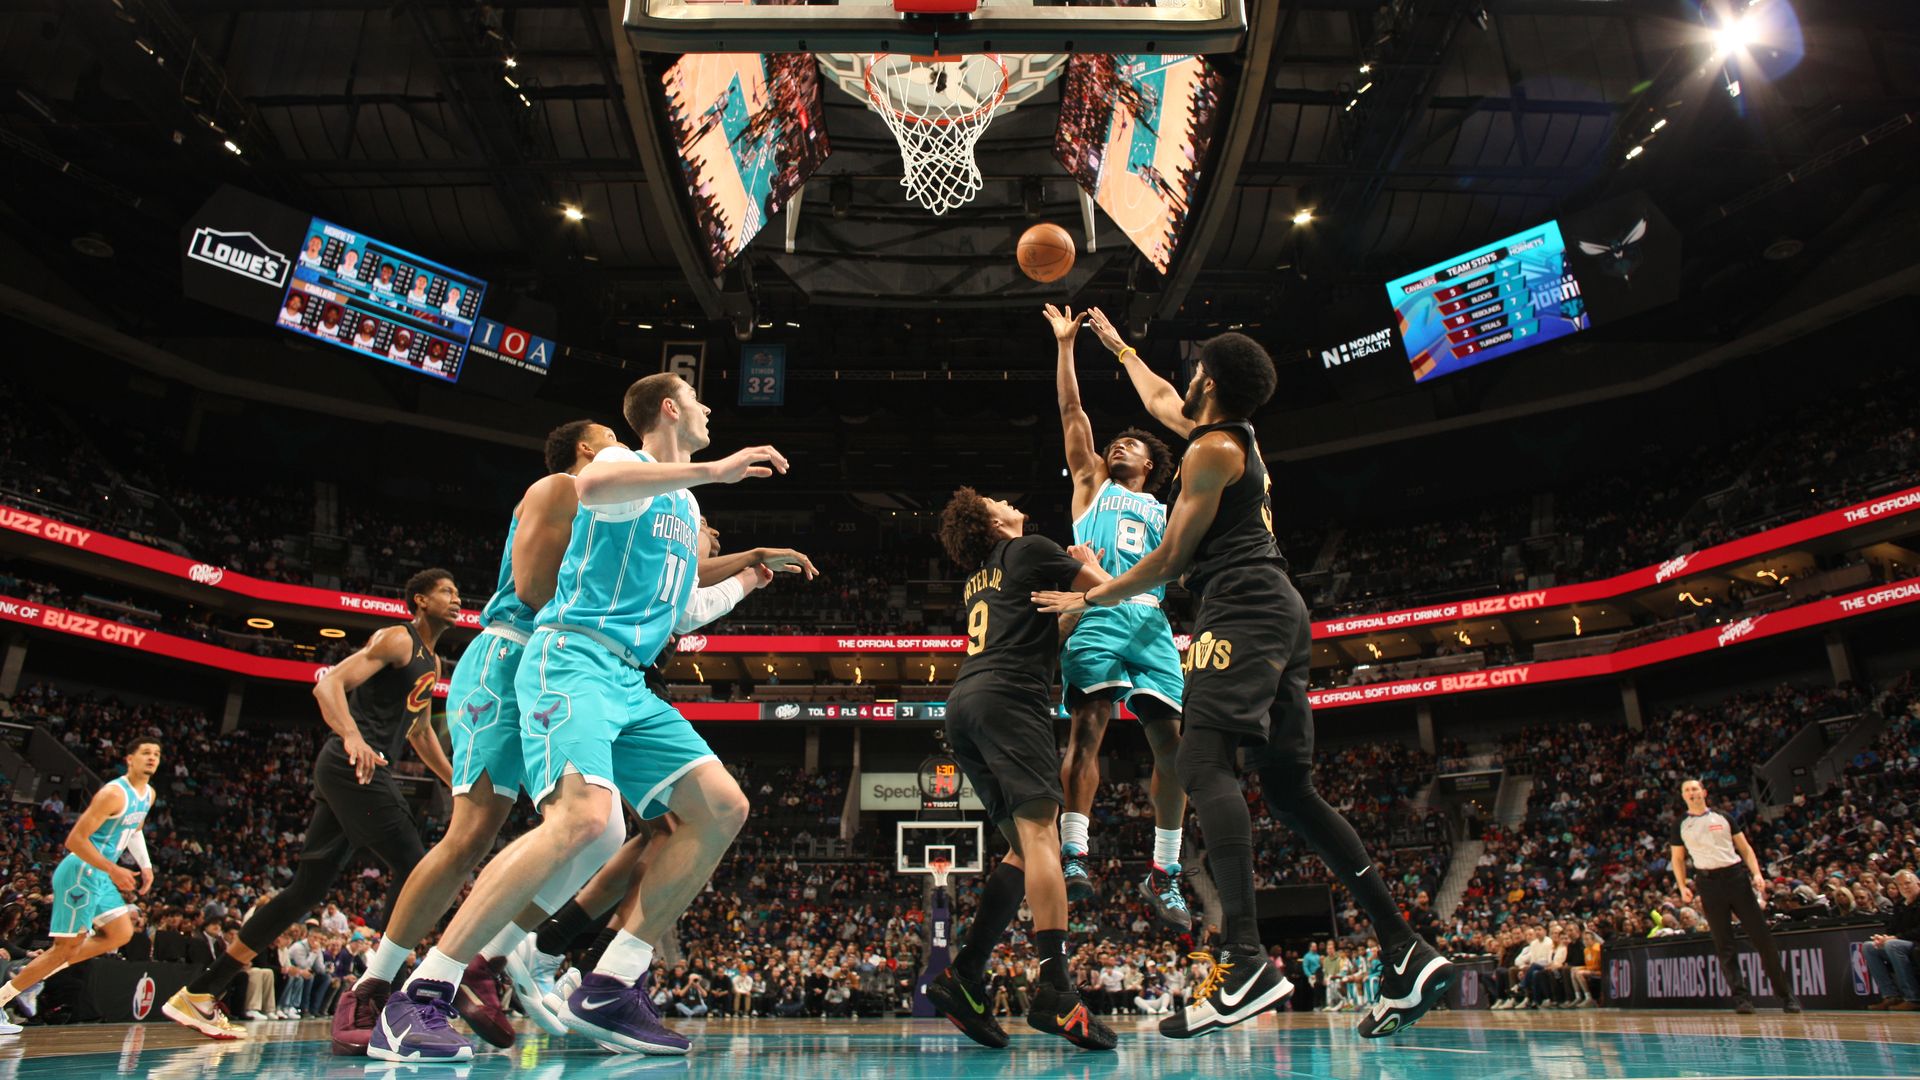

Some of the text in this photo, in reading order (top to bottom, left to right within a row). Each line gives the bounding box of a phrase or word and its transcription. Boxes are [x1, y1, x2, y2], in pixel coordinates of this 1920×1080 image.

[201, 235, 279, 280] LOWE'S
[1446, 262, 1471, 277] TEAM
[1471, 252, 1498, 269] STATS
[1471, 291, 1493, 304] BLOCKS
[1471, 304, 1501, 319] REBOUNDS
[1348, 327, 1391, 350] NOVANT
[1479, 332, 1512, 347] TURNOVERS
[1480, 320, 1501, 332] STEALS
[469, 345, 498, 359] INSURANCE
[499, 355, 517, 366] OFFICE
[525, 363, 547, 376] AMERICA
[1352, 338, 1391, 359] HEALTH
[748, 377, 775, 394] 32
[0, 509, 90, 546] UZZ CITY
[1100, 495, 1164, 532] HORNETS
[1844, 507, 1869, 522] THE
[653, 513, 697, 557] HORNETS
[1117, 518, 1146, 554] 8
[659, 552, 687, 607] 11
[964, 567, 1003, 606] RTER JR.
[340, 596, 405, 614] THE OFFICIAL
[1326, 592, 1546, 633] THE OFFICIAL SOFT DRINK OF BUZZ CITY
[1840, 596, 1866, 611] THE
[20, 606, 39, 618] OF
[42, 609, 100, 636] BUZZ
[101, 623, 146, 647] CITY
[967, 600, 988, 656] 9
[838, 639, 964, 648] THE OFFICIAL SOFT DRINK OF
[1184, 632, 1232, 675] AVS
[1321, 690, 1363, 704] OFFICIAL
[1364, 686, 1390, 698] SOFT
[1391, 682, 1422, 695] DRINK
[1423, 680, 1438, 691] OF
[1441, 673, 1488, 692] BUZZ
[1490, 668, 1529, 685] CITY
[808, 706, 946, 717] TOL 6 FLS 4 CLE 31 1:3
[936, 765, 955, 776] 1:30
[1647, 954, 1706, 998] REWARDS
[1707, 954, 1732, 997] FO
[1790, 947, 1827, 996] FAN
